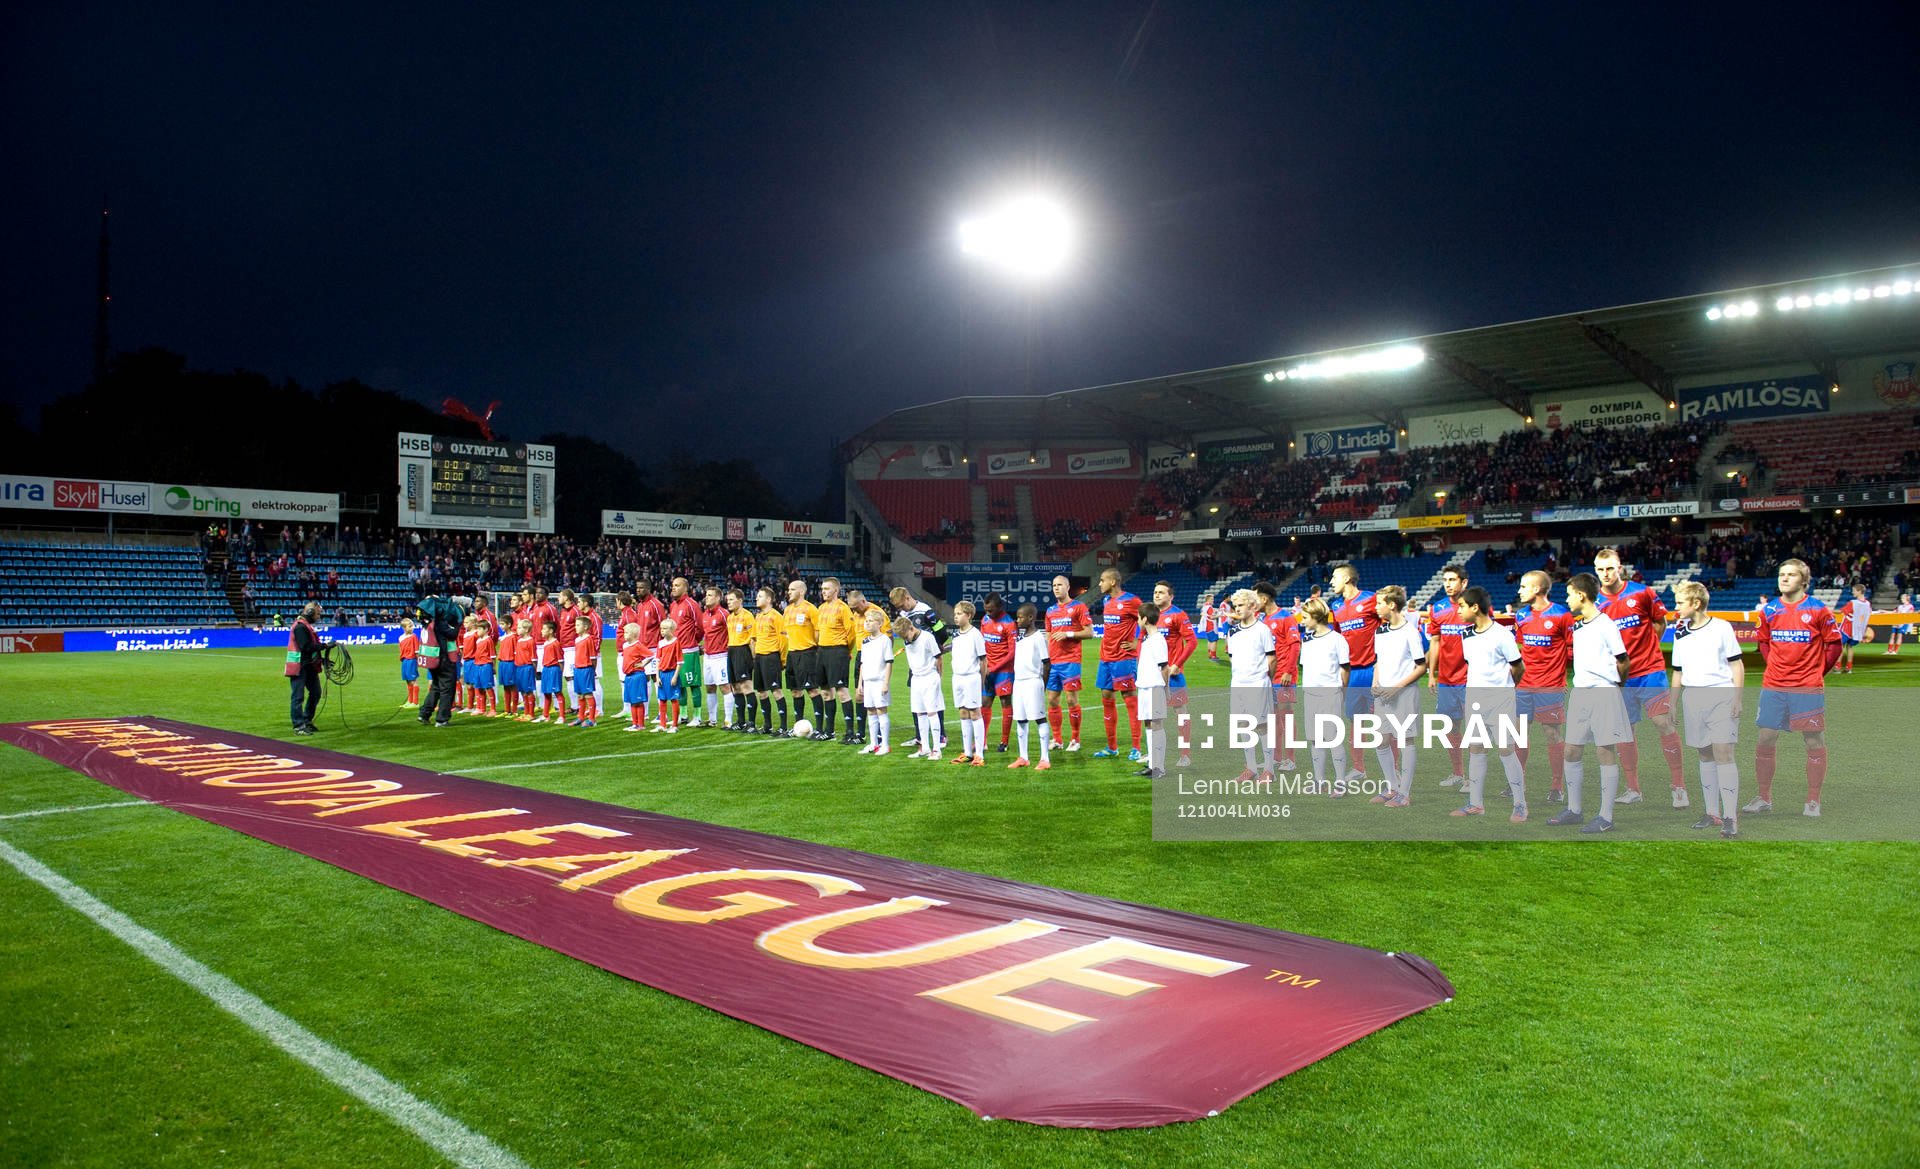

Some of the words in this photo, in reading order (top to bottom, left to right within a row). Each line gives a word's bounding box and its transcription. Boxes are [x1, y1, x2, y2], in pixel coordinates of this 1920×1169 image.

[1589, 400, 1643, 414] OLYMPIA
[1682, 380, 1824, 422] RAMLÖSA
[1574, 412, 1661, 429] HELSINGBORG
[1442, 423, 1484, 441] Valvet
[400, 438, 431, 451] HSB
[1337, 430, 1391, 449] Lindab
[450, 443, 509, 458] OLYMPIA
[528, 449, 554, 461] HSB
[1150, 456, 1179, 469] NCC
[0, 482, 44, 501] ira
[193, 496, 240, 516] bring
[252, 501, 328, 513] elektrokoppar
[1631, 506, 1644, 515] LK
[1646, 503, 1692, 514] Armatur
[1764, 499, 1801, 508] MEGAPOL
[784, 521, 812, 535] MAXI
[1280, 524, 1327, 534] OPTIMERA
[1035, 564, 1067, 573] company
[962, 580, 1051, 593] RESURS
[962, 594, 1012, 604] BAK
[685, 672, 693, 681] 13
[110, 743, 443, 817] EUROPA
[354, 808, 1251, 1033] LEAGUE
